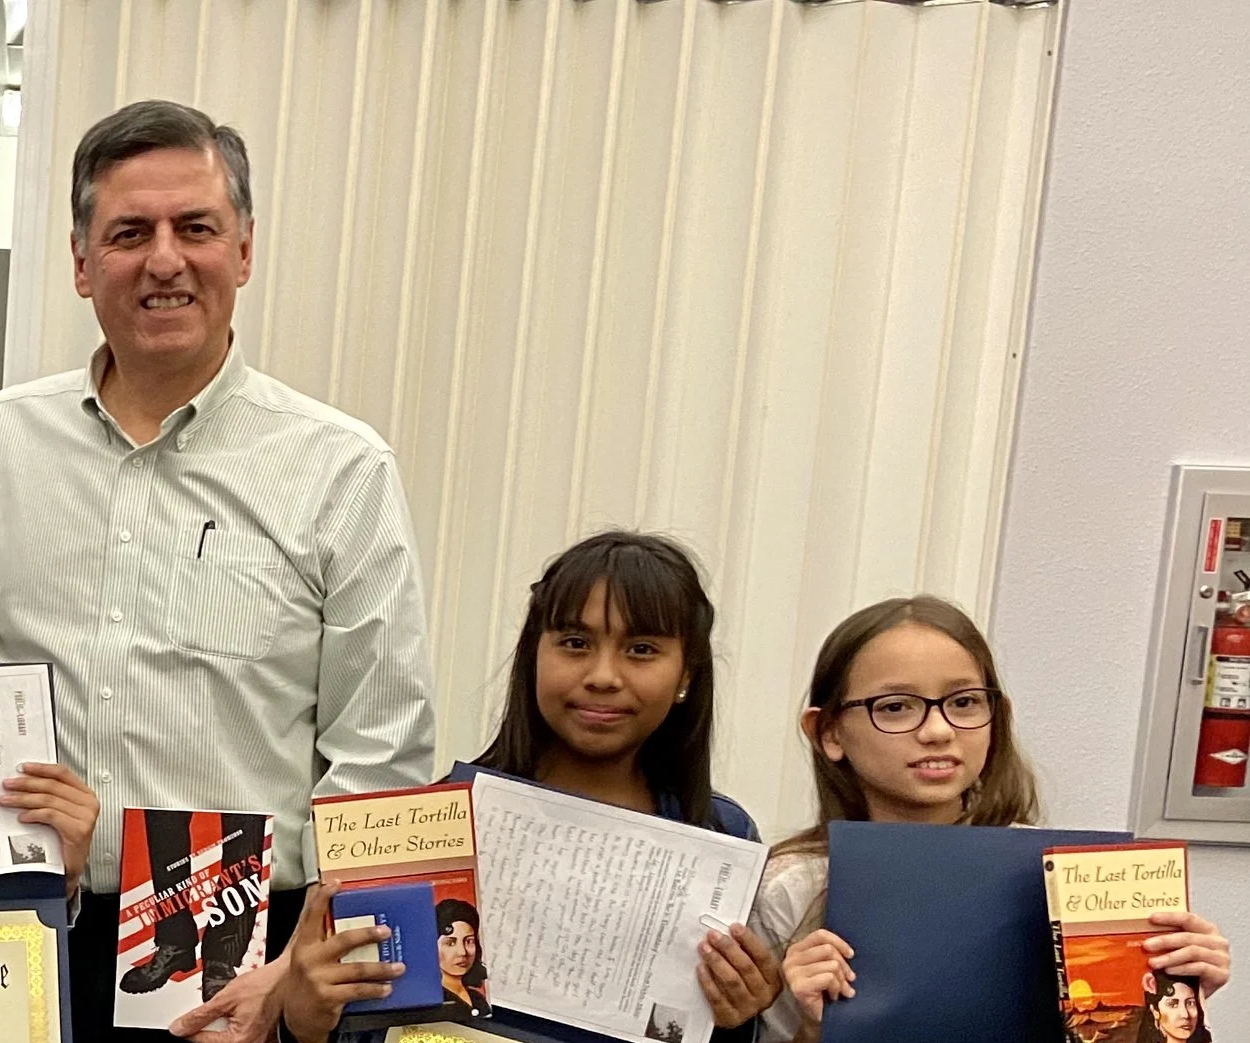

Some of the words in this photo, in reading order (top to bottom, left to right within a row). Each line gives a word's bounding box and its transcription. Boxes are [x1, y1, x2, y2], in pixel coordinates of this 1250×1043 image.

[324, 814, 356, 833] The
[364, 813, 400, 829] Last
[409, 802, 467, 825] Tortilla
[327, 844, 346, 860] &
[351, 837, 400, 858] Other
[406, 834, 465, 852] Stories
[1063, 866, 1090, 885] The
[1095, 865, 1126, 883] Last
[1133, 860, 1182, 881] Tortilla
[125, 909, 132, 917] A
[134, 888, 175, 913] PECULIAR
[176, 875, 198, 891] KIND
[199, 869, 210, 882] OF
[139, 854, 262, 926] IMMIGRANT'S
[201, 874, 262, 927] SON
[1066, 895, 1083, 912] &
[1085, 891, 1126, 911] Other
[1131, 891, 1180, 908] Stories
